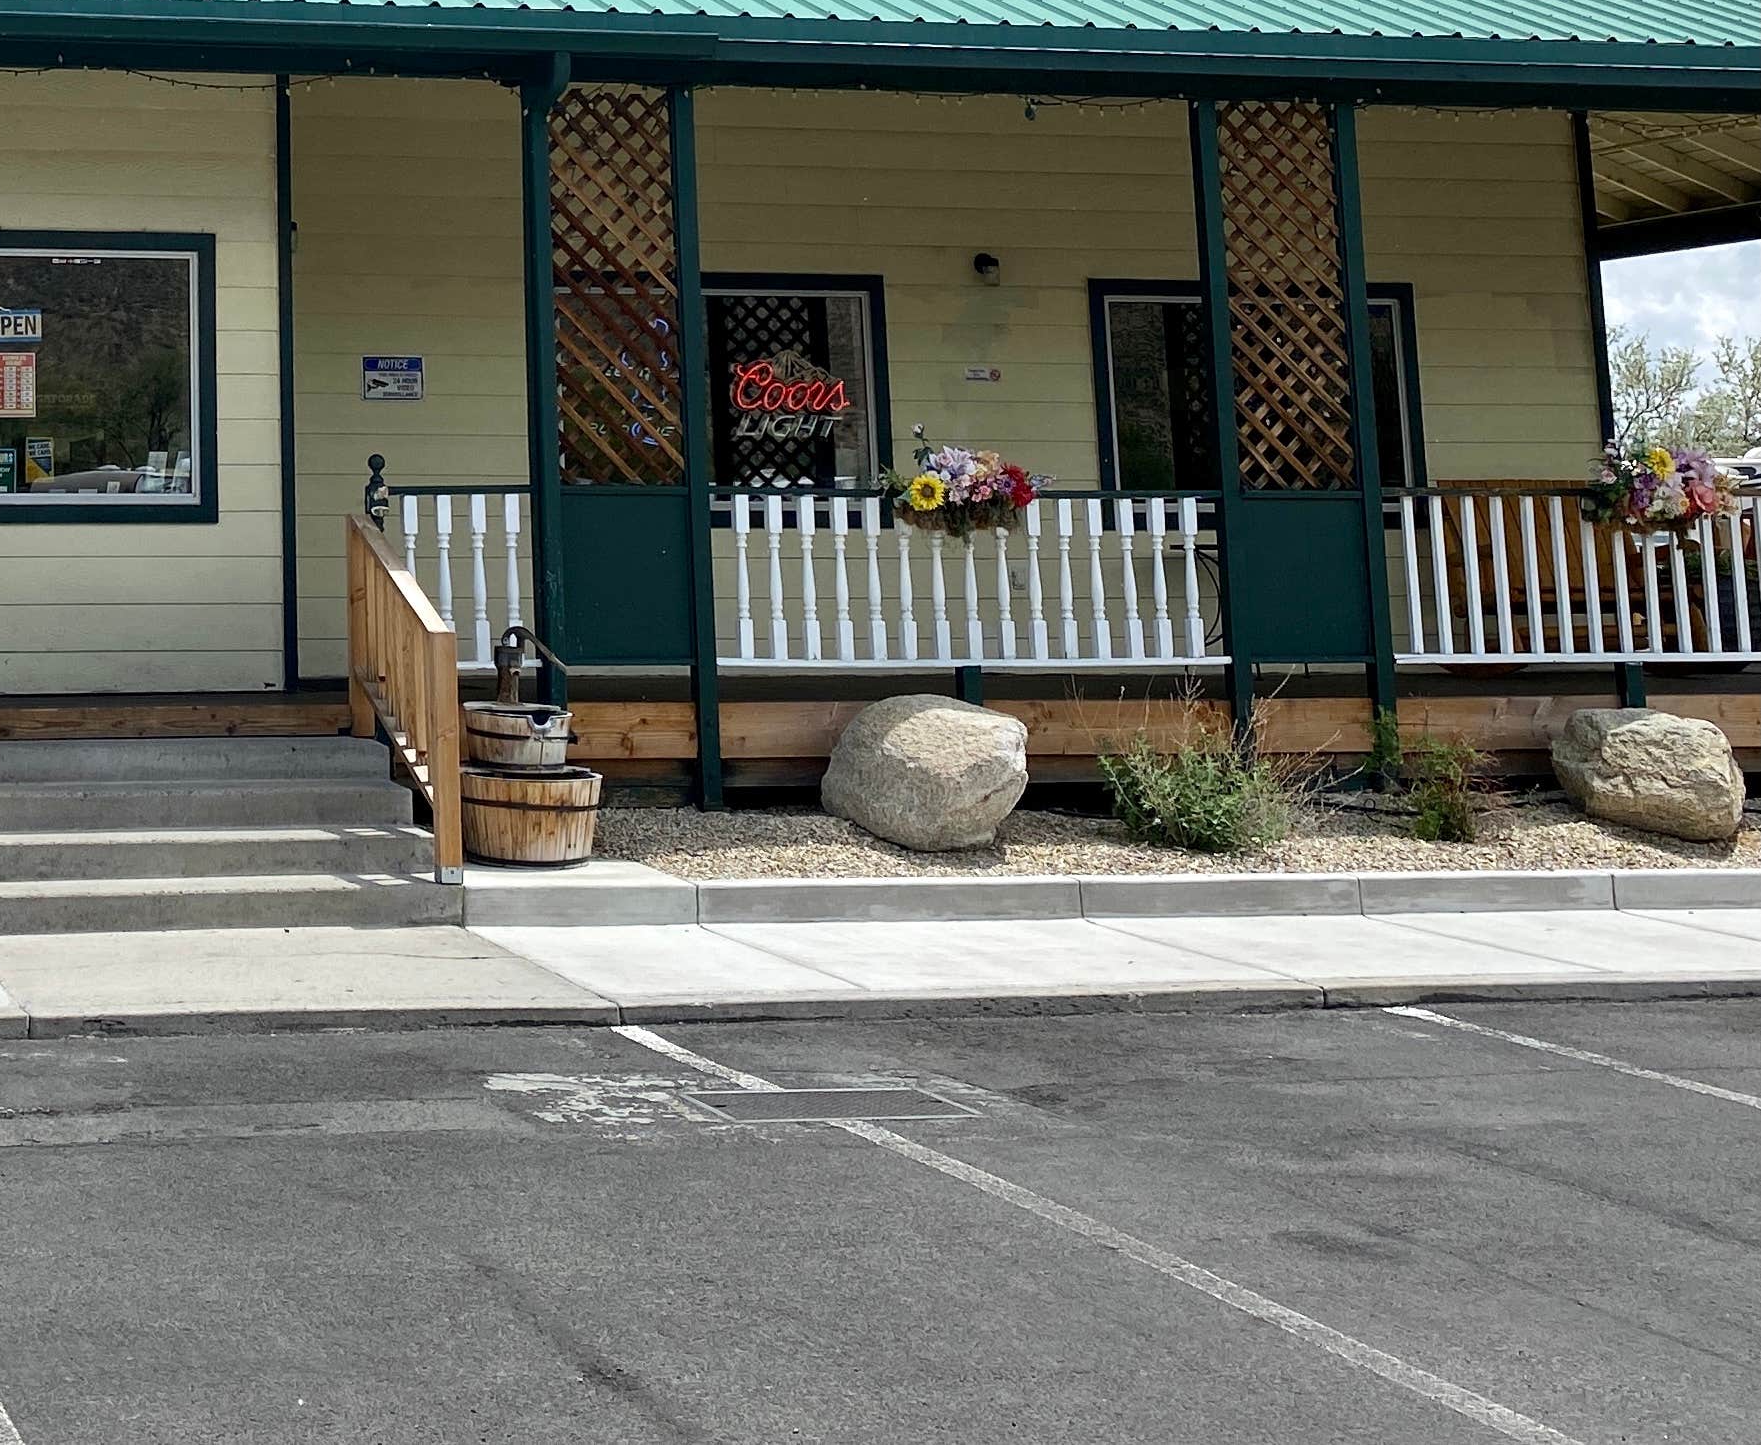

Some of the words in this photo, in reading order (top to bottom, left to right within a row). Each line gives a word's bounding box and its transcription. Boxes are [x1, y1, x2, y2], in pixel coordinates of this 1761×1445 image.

[377, 359, 409, 370] NOTICE
[732, 359, 851, 413] Coors
[734, 414, 844, 439] LIGHT
